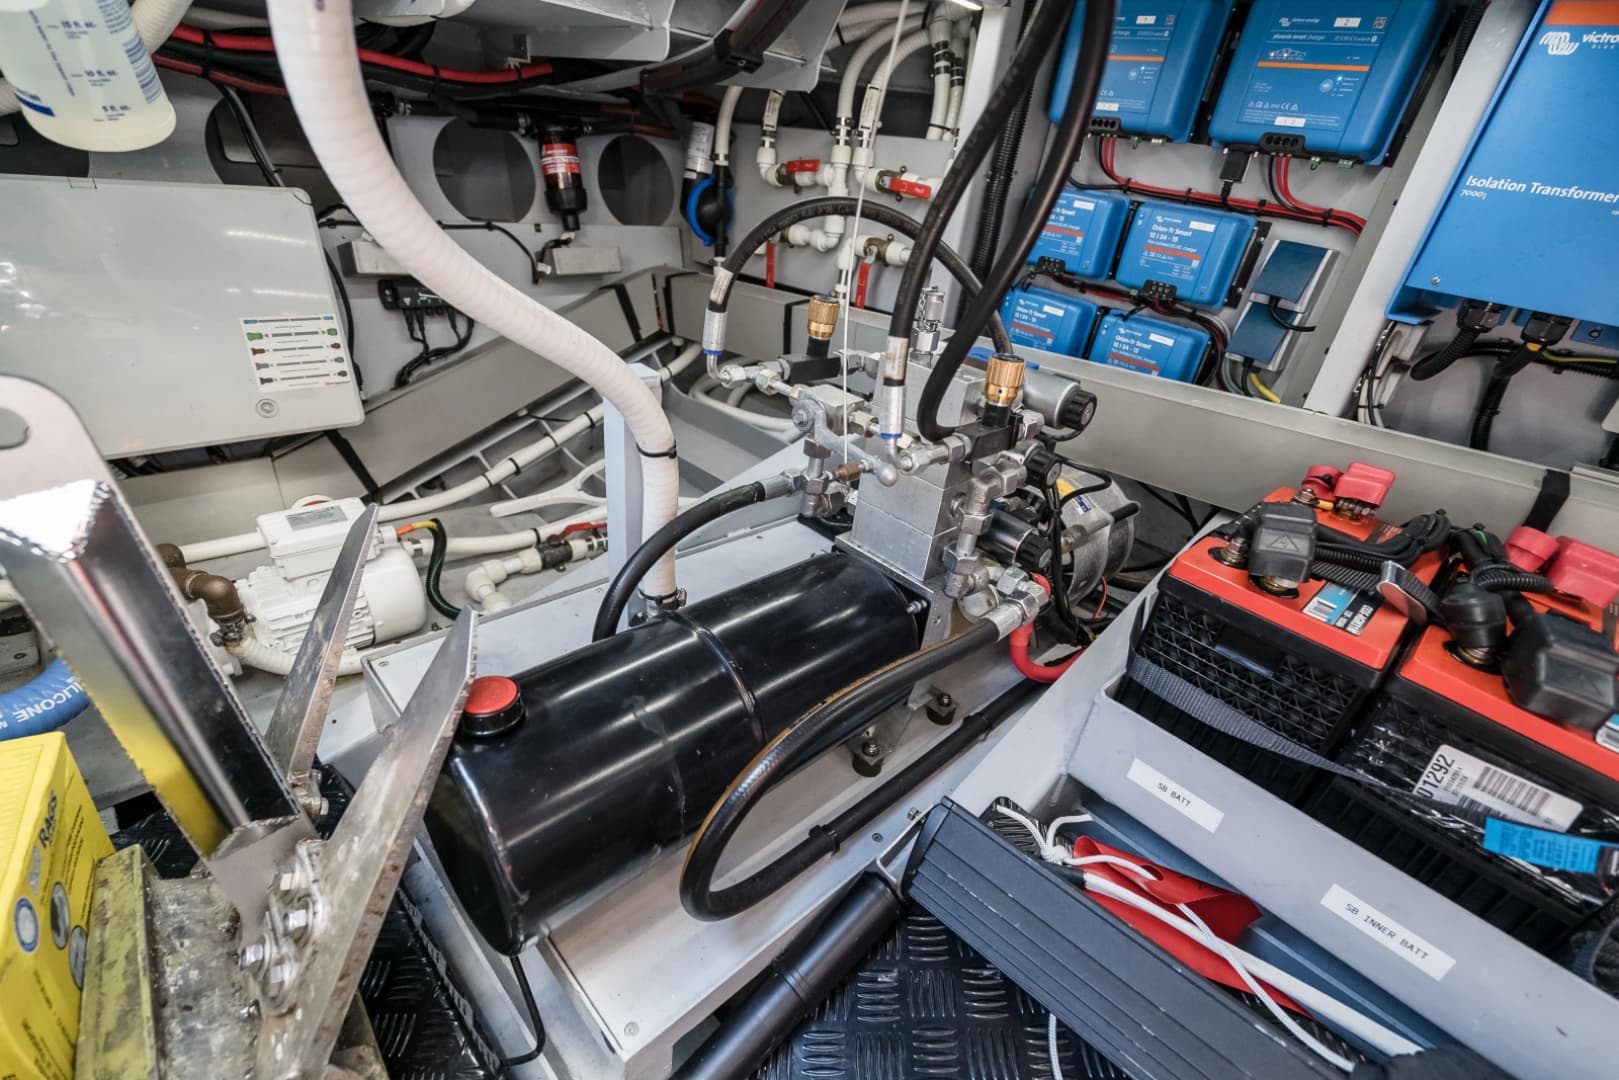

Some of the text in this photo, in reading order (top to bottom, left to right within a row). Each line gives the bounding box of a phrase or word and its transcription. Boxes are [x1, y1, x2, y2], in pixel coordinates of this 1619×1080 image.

[1466, 175, 1619, 204] Isolation Transformer
[12, 681, 83, 723] ILICONE
[1416, 754, 1455, 799] 01292
[1170, 790, 1192, 808] BATT
[1345, 903, 1429, 960] SB INNER BATT
